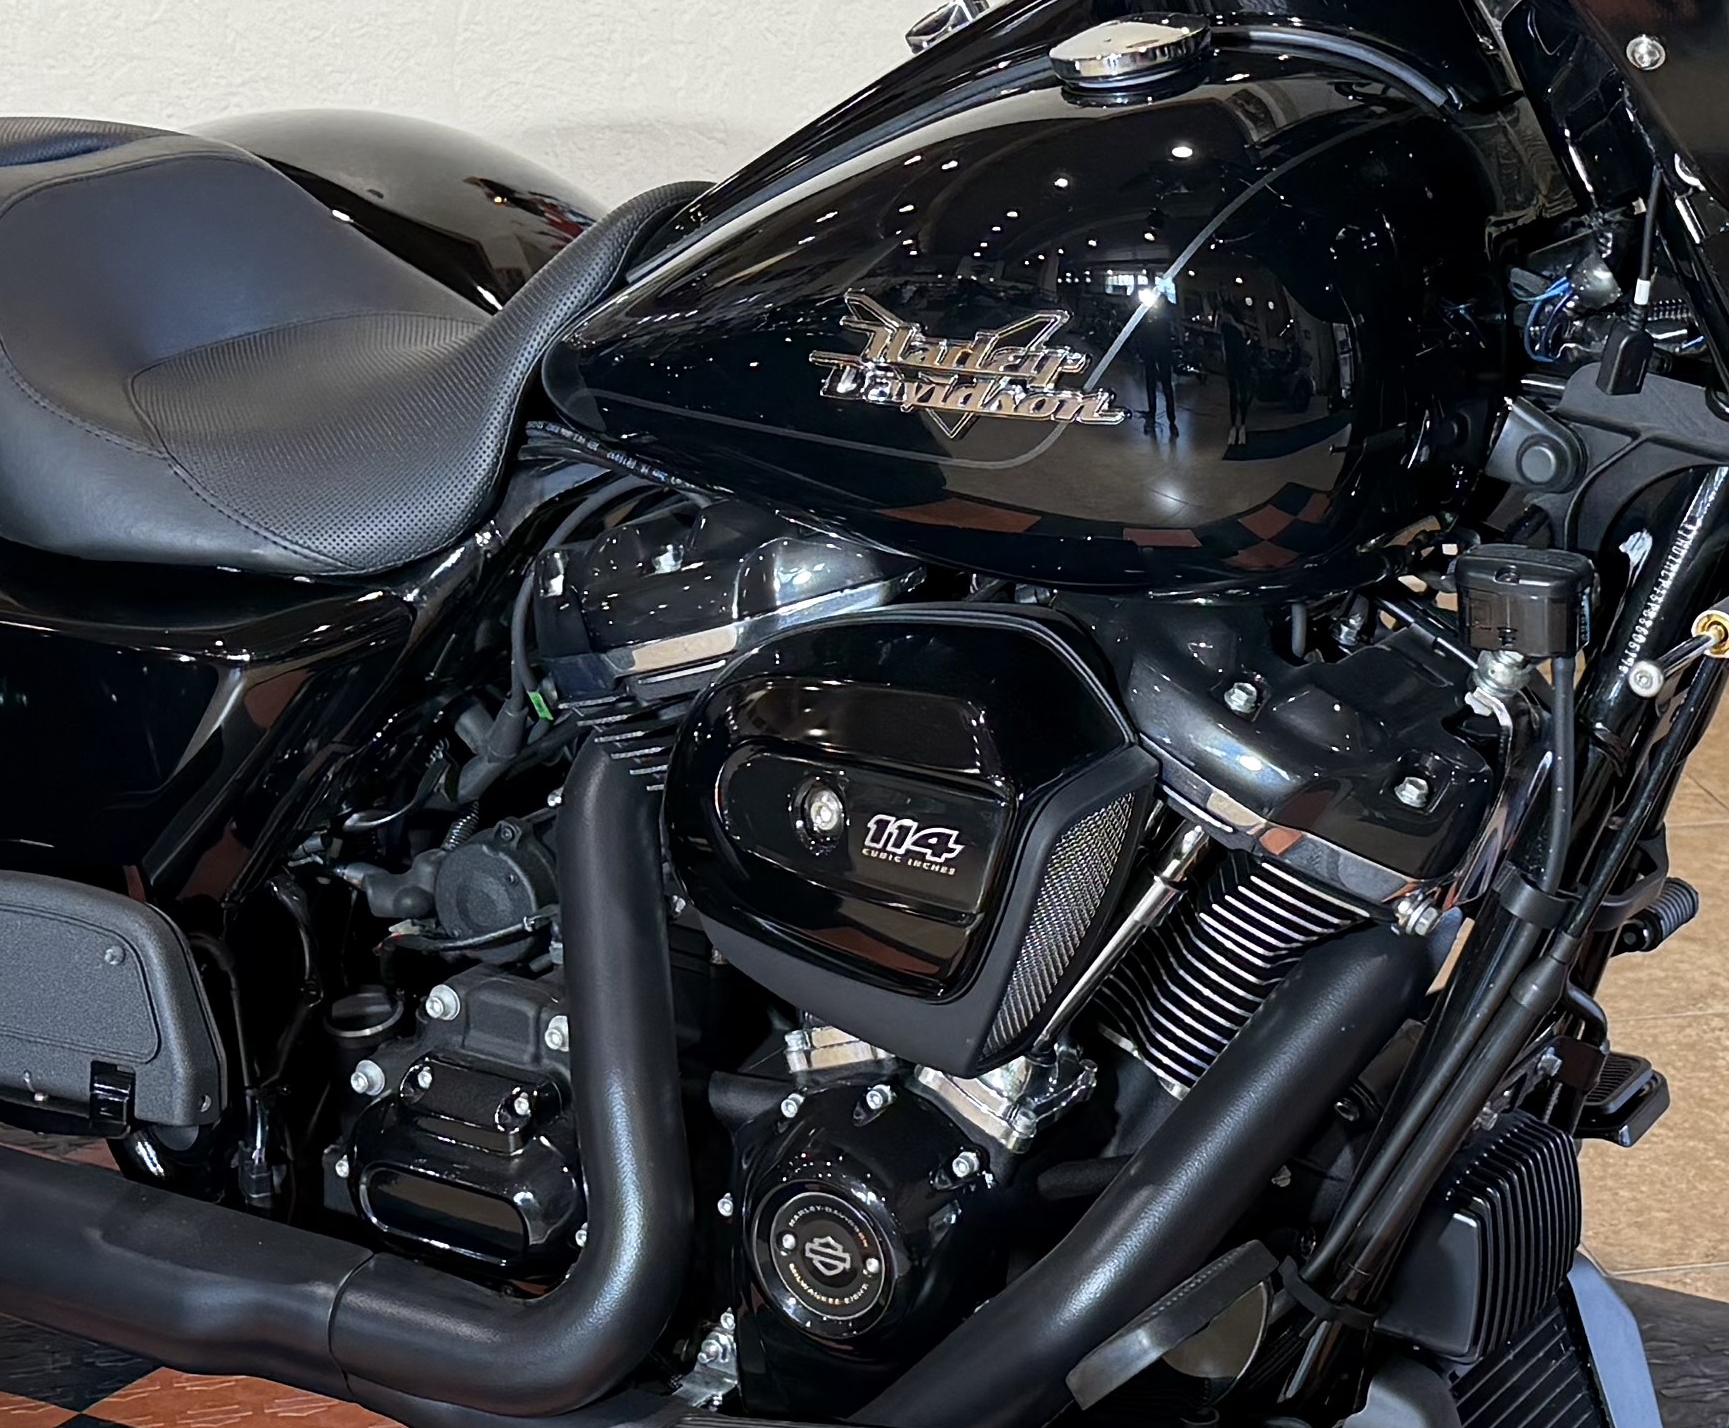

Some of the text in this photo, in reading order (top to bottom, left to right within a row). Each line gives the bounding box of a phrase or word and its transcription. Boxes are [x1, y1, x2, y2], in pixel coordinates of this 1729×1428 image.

[839, 317, 1093, 391] Harley
[809, 352, 1131, 425] Davidson
[861, 847, 957, 876] CUBIC INCHES
[864, 814, 965, 863] 114
